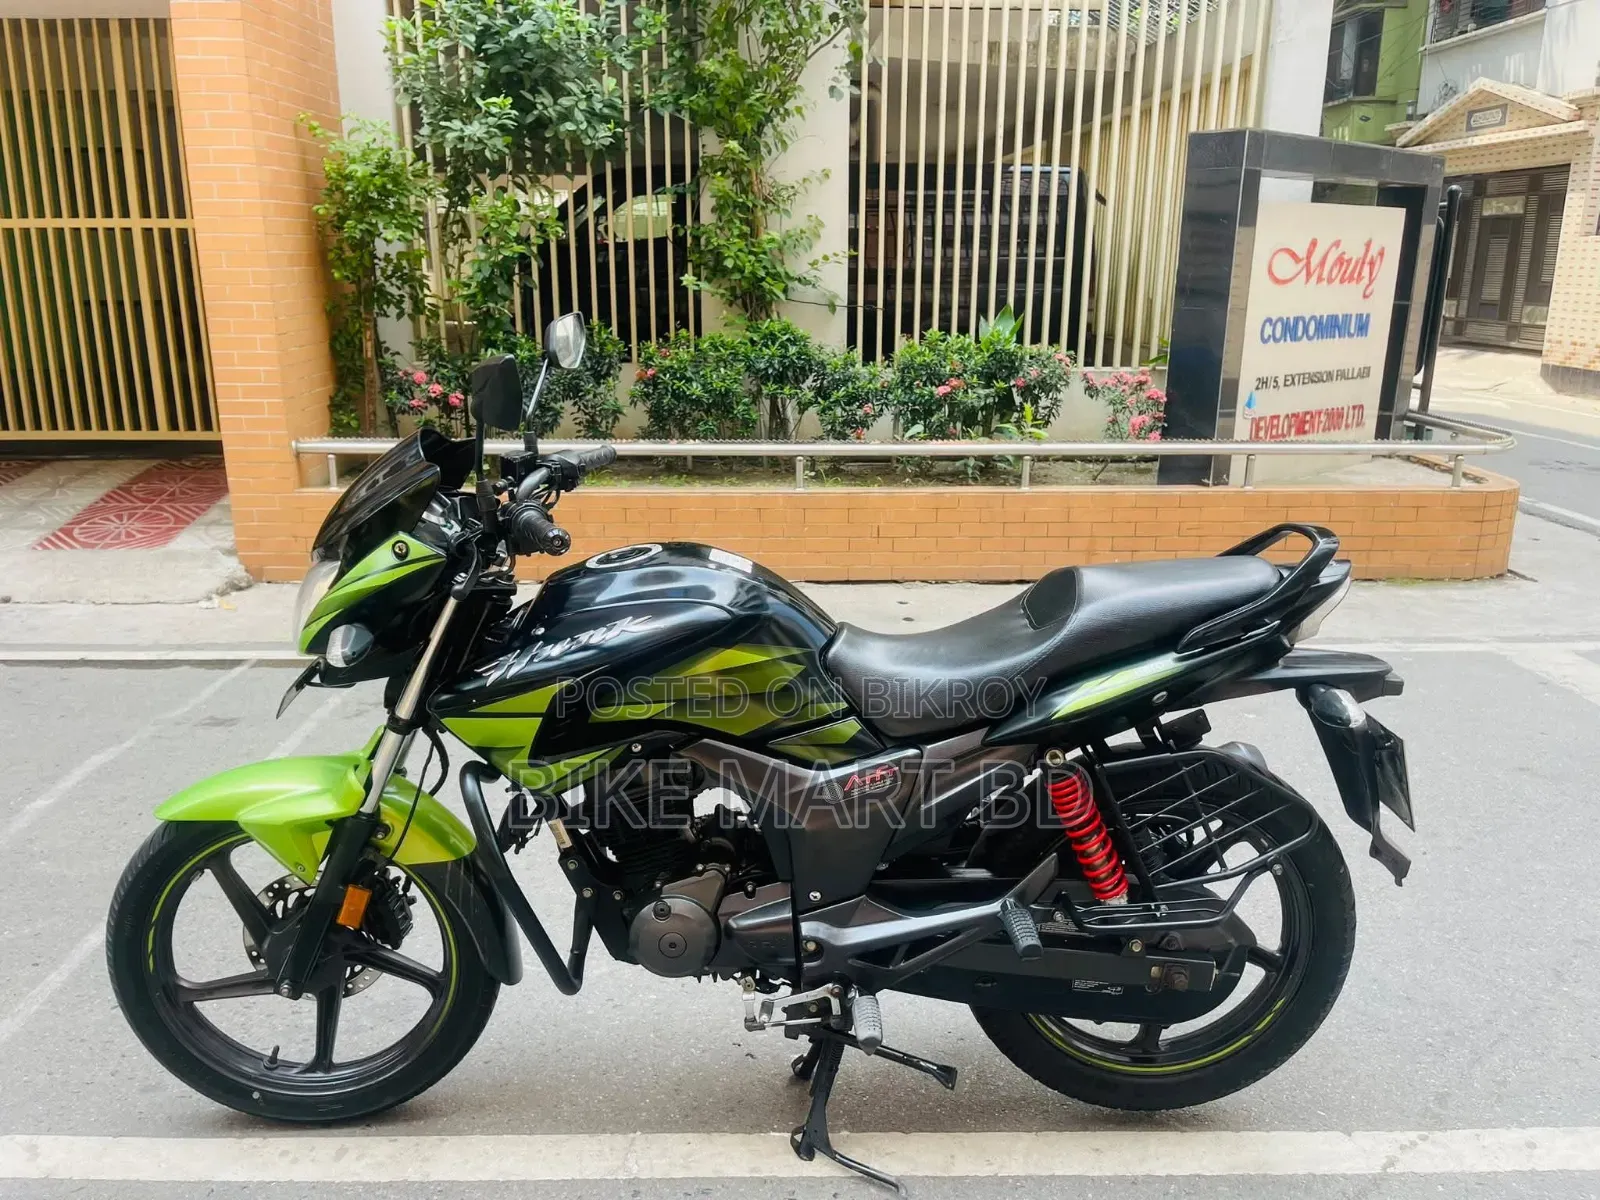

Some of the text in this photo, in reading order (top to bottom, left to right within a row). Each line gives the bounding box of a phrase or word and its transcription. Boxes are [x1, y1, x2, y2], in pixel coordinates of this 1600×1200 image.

[1267, 237, 1386, 299] Mouly
[1260, 313, 1371, 344] CONDOMINIUM
[1283, 370, 1334, 387] EXTENSION
